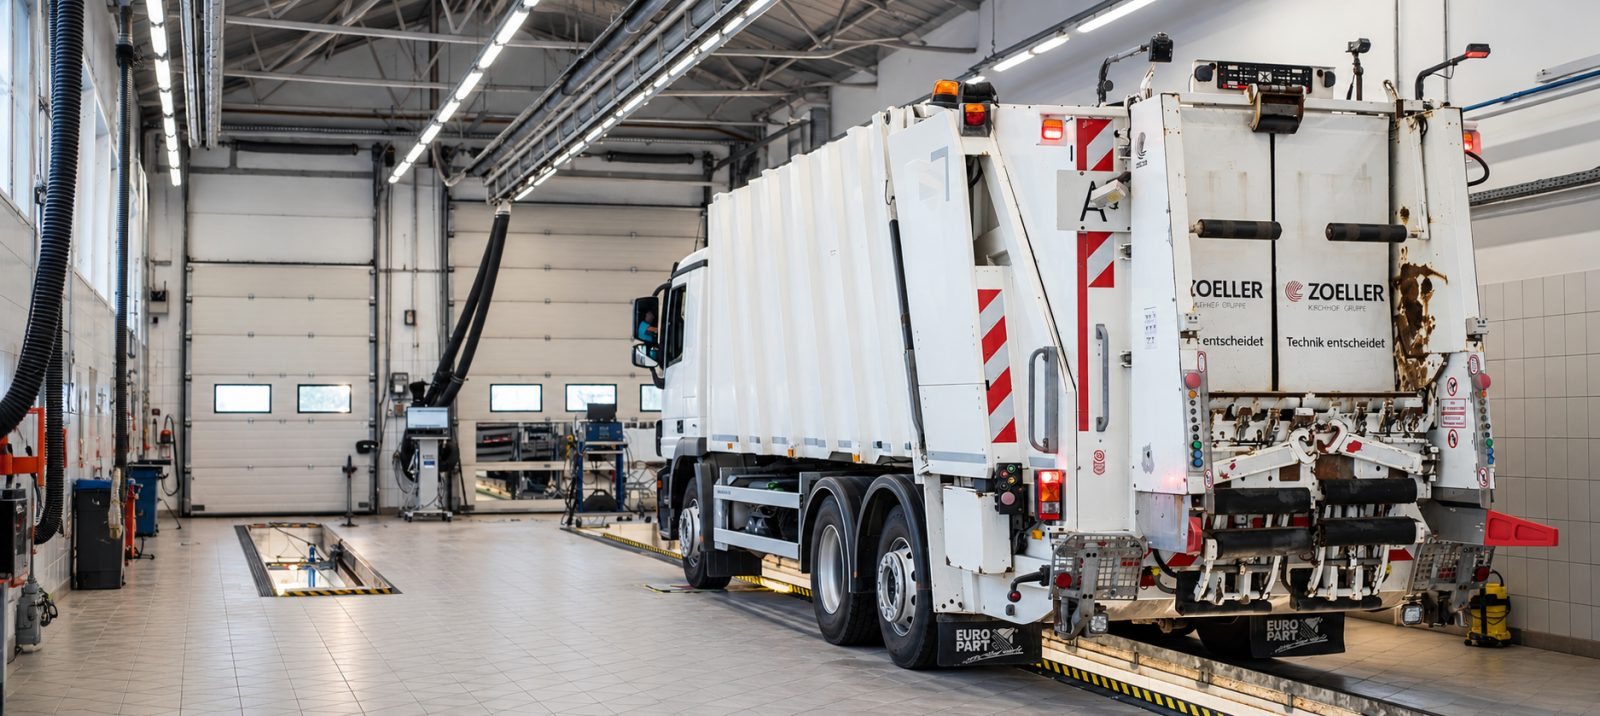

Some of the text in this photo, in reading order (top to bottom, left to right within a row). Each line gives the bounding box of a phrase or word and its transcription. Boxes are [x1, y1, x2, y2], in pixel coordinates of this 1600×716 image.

[1308, 283, 1384, 301] ZOELLER
[1202, 336, 1264, 346] entscheidet
[1286, 336, 1385, 348] Technik entscheidet
[1266, 620, 1299, 632] EURO
[956, 629, 990, 640] EURO
[1266, 630, 1298, 641] PART
[956, 640, 990, 652] PART
